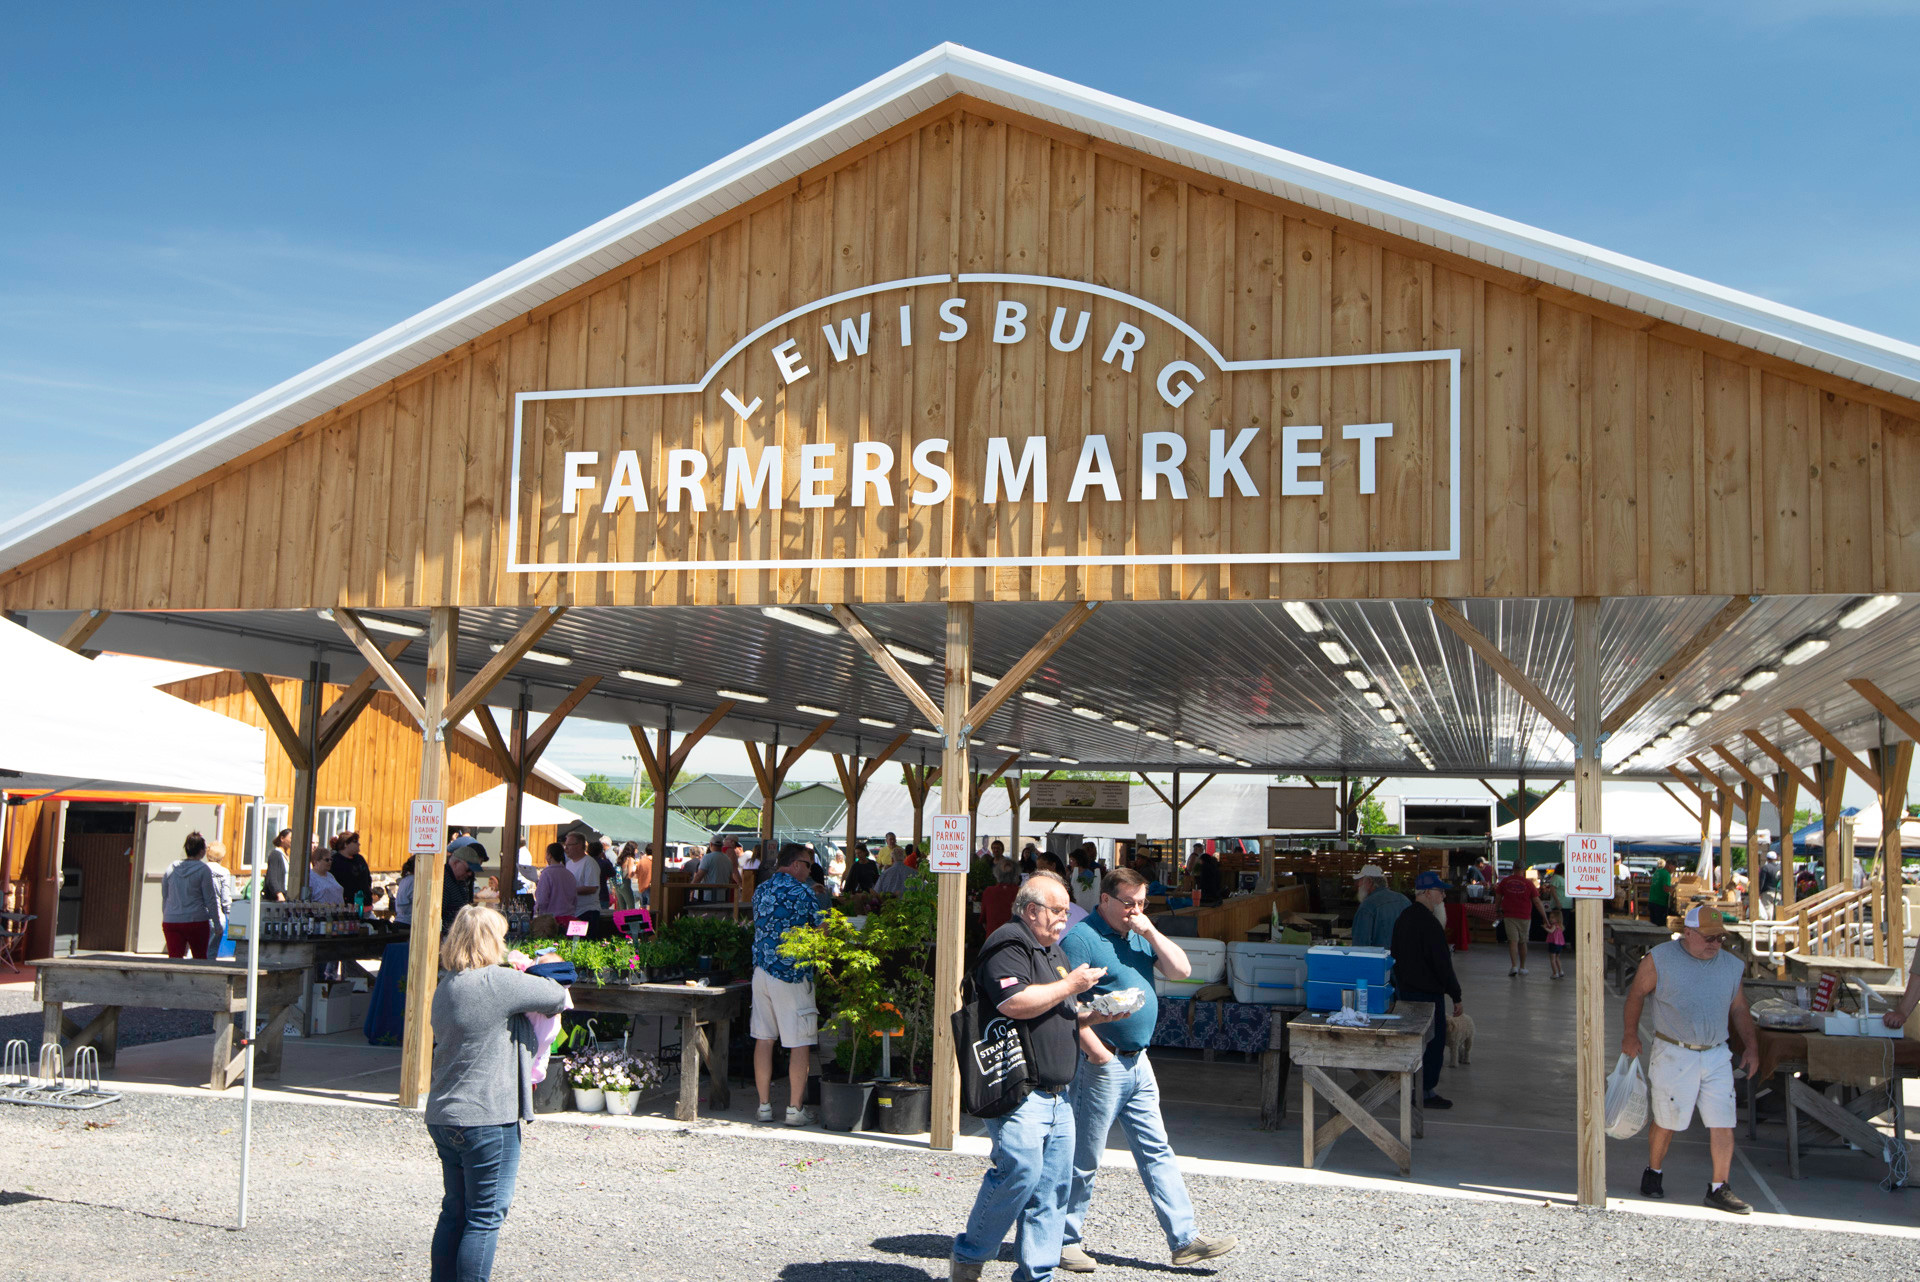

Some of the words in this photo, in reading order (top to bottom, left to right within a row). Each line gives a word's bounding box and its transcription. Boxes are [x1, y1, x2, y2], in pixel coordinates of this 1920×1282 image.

[720, 298, 1206, 421] LEWISBURG
[561, 438, 953, 514] FARMERS
[983, 422, 1394, 504] MARKET
[421, 804, 433, 814] NO
[414, 815, 440, 825] PARKING
[944, 819, 957, 829] NO
[414, 826, 438, 834] LOADING
[935, 831, 965, 841] PARKING
[936, 843, 964, 851] LOADING
[1581, 839, 1597, 850] NO
[942, 851, 958, 859] ZONE
[1571, 851, 1608, 864] PARKING
[1572, 865, 1606, 874] LOADING
[1579, 874, 1600, 882] ZONE
